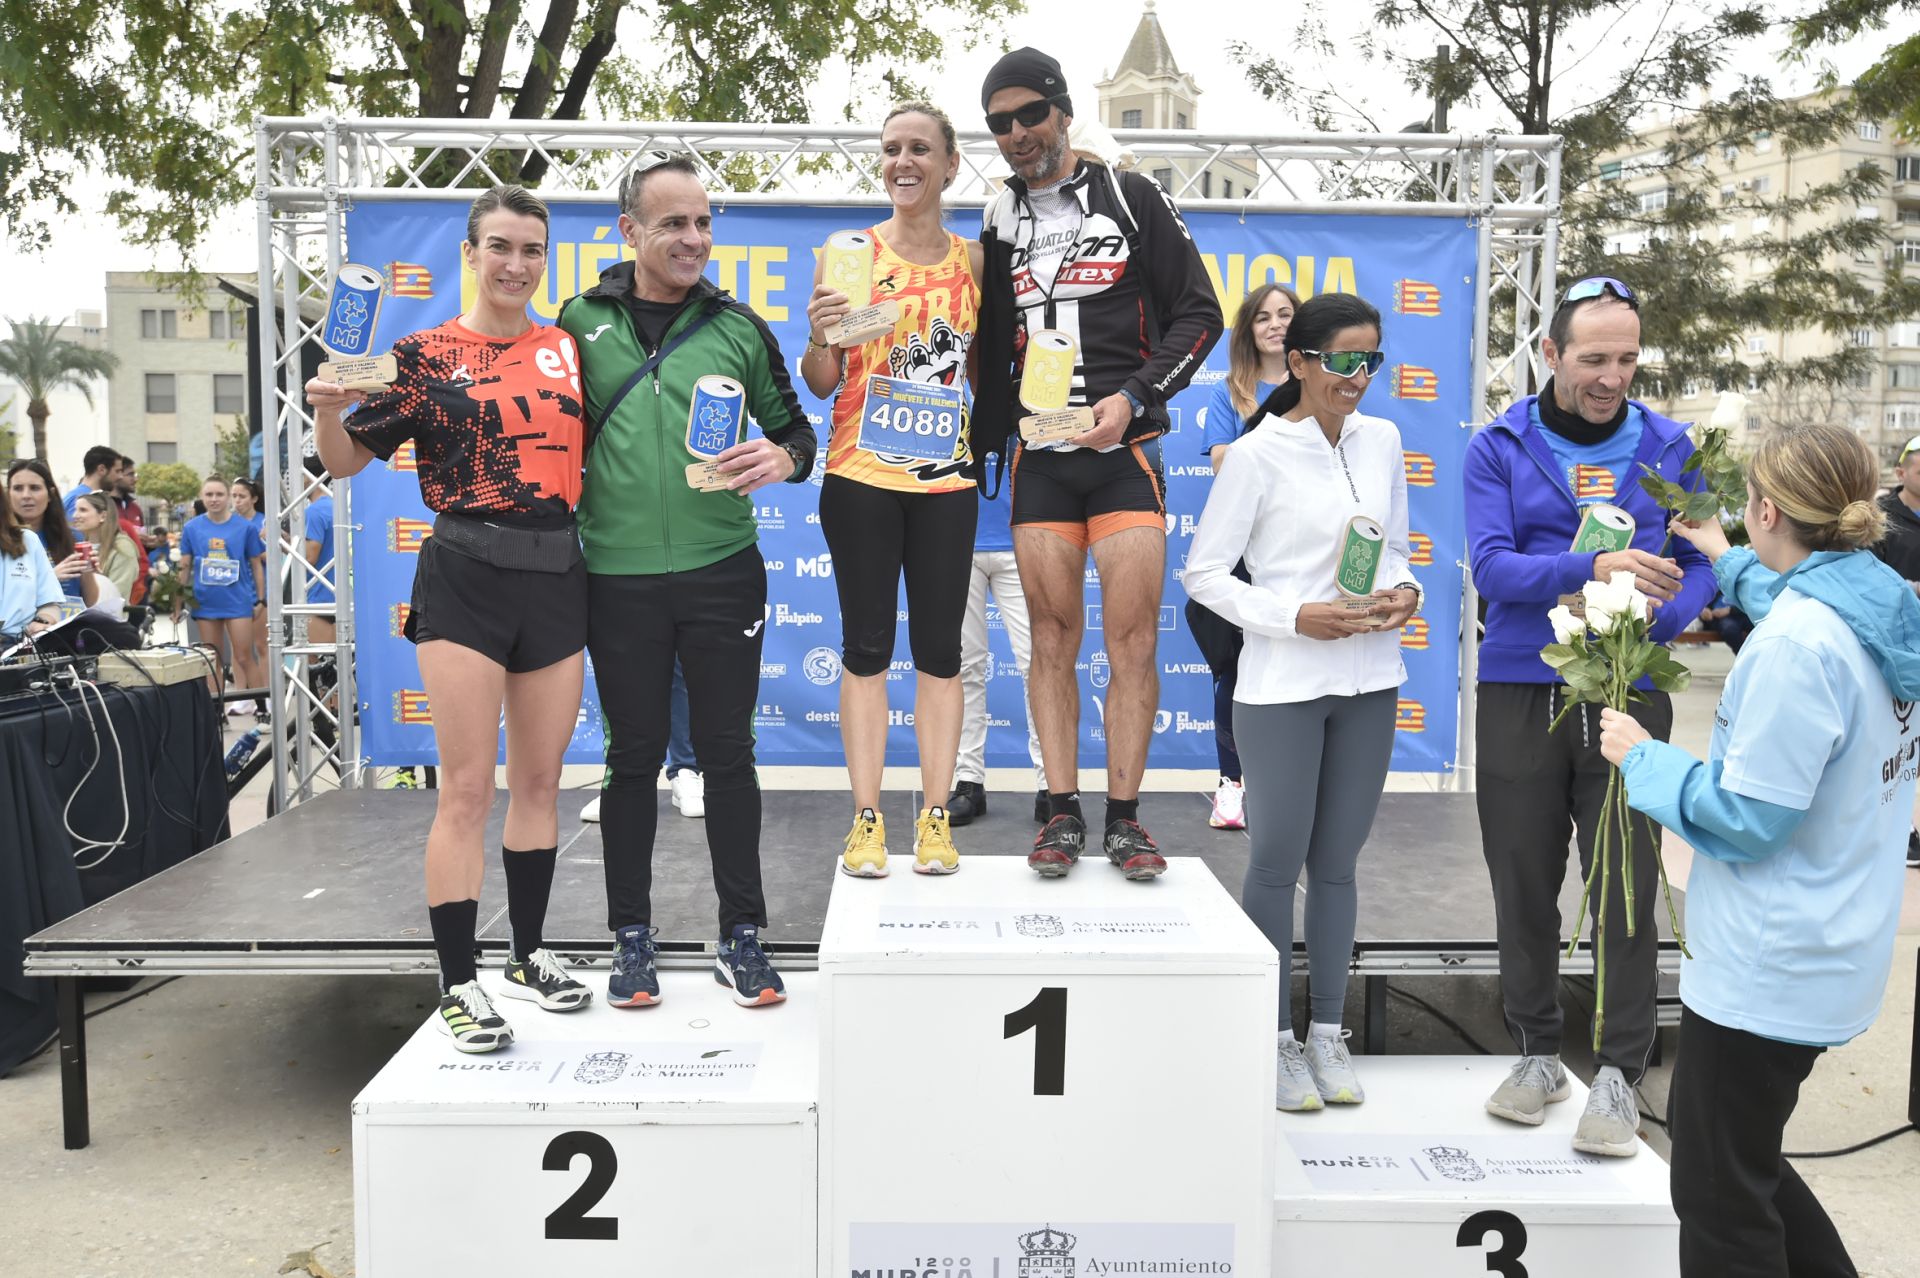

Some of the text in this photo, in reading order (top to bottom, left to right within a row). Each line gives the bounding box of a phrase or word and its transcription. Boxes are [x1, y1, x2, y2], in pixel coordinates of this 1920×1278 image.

[870, 402, 954, 438] 4088
[1169, 466, 1186, 476] LA
[1181, 514, 1194, 526] El
[796, 553, 832, 578] MÚ
[207, 567, 232, 578] 964
[775, 604, 789, 615] El
[775, 612, 823, 627] pulpito
[1165, 663, 1182, 674] LA
[1176, 711, 1189, 722] El
[1071, 921, 1192, 929] Ayuntamiento
[1003, 986, 1068, 1096] 1
[438, 1063, 541, 1072] MURCIA
[633, 1061, 756, 1070] Ayuntamiento
[630, 1069, 725, 1078] de Murcia
[1301, 1158, 1400, 1169] MURCIA
[1485, 1157, 1601, 1169] Ayuntamiento
[1491, 1166, 1583, 1177] de Murcia
[541, 1130, 619, 1241] 2
[1455, 1209, 1529, 1278] 3
[914, 1257, 1232, 1277] 1200 Ayuntamiento
